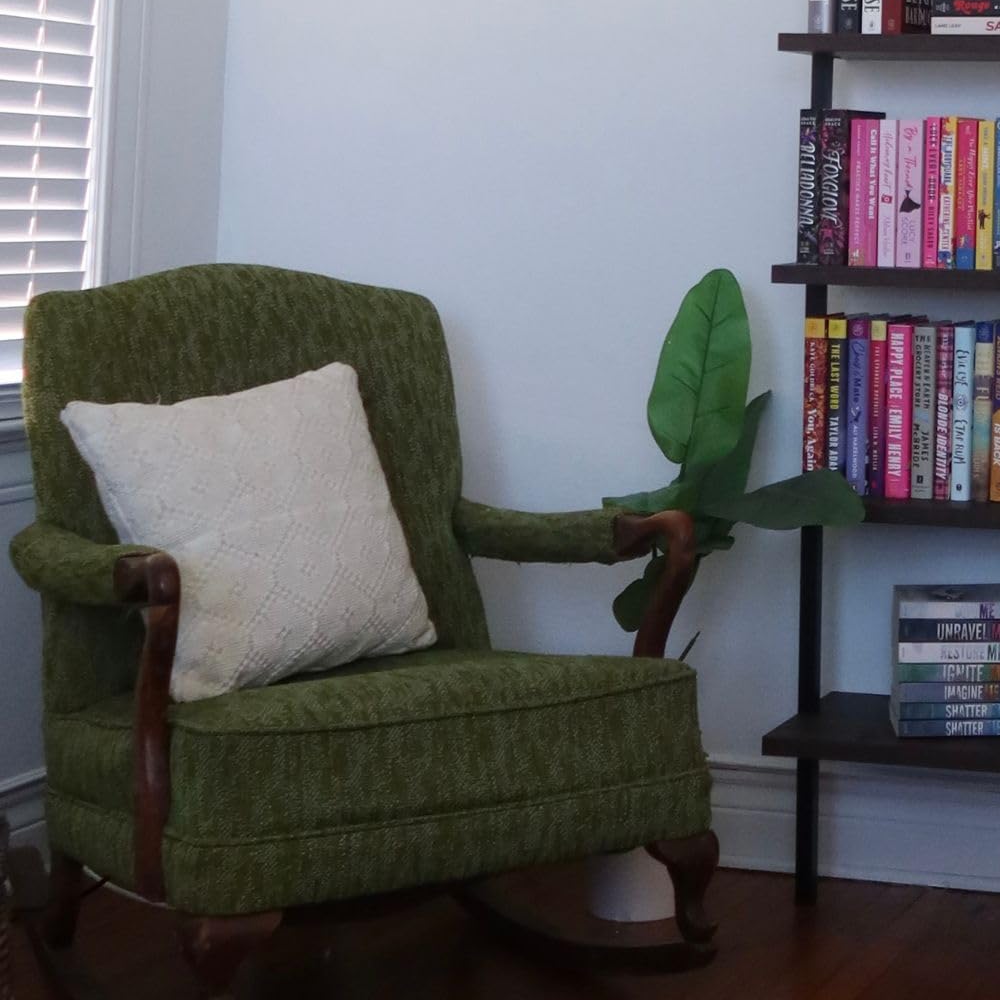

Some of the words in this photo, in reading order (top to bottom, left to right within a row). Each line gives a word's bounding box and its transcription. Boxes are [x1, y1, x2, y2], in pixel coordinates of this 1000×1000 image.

[800, 142, 816, 228] BELLADONNA
[820, 150, 843, 225] FOXGLOVE
[868, 196, 876, 219] Want
[831, 344, 841, 359] THE
[890, 333, 905, 365] HAPPY
[830, 362, 840, 382] LAST
[889, 368, 903, 400] PLACE
[829, 385, 840, 410] WORD
[806, 408, 818, 435] You,
[888, 408, 902, 439] EMILY
[936, 391, 948, 433] BLONDE
[829, 416, 839, 447] TAYLOR
[806, 436, 818, 471] Again
[887, 443, 901, 476] HENRY
[921, 430, 929, 462] JAMES
[935, 433, 947, 479] IDENTITY
[954, 443, 967, 465] RUM
[980, 603, 995, 619] ME
[937, 623, 987, 641] UNRAVEL
[943, 664, 985, 682] IGNITE
[944, 685, 984, 700] IMAGINE
[945, 704, 988, 718] SHATTER
[945, 721, 984, 736] SHATTER
